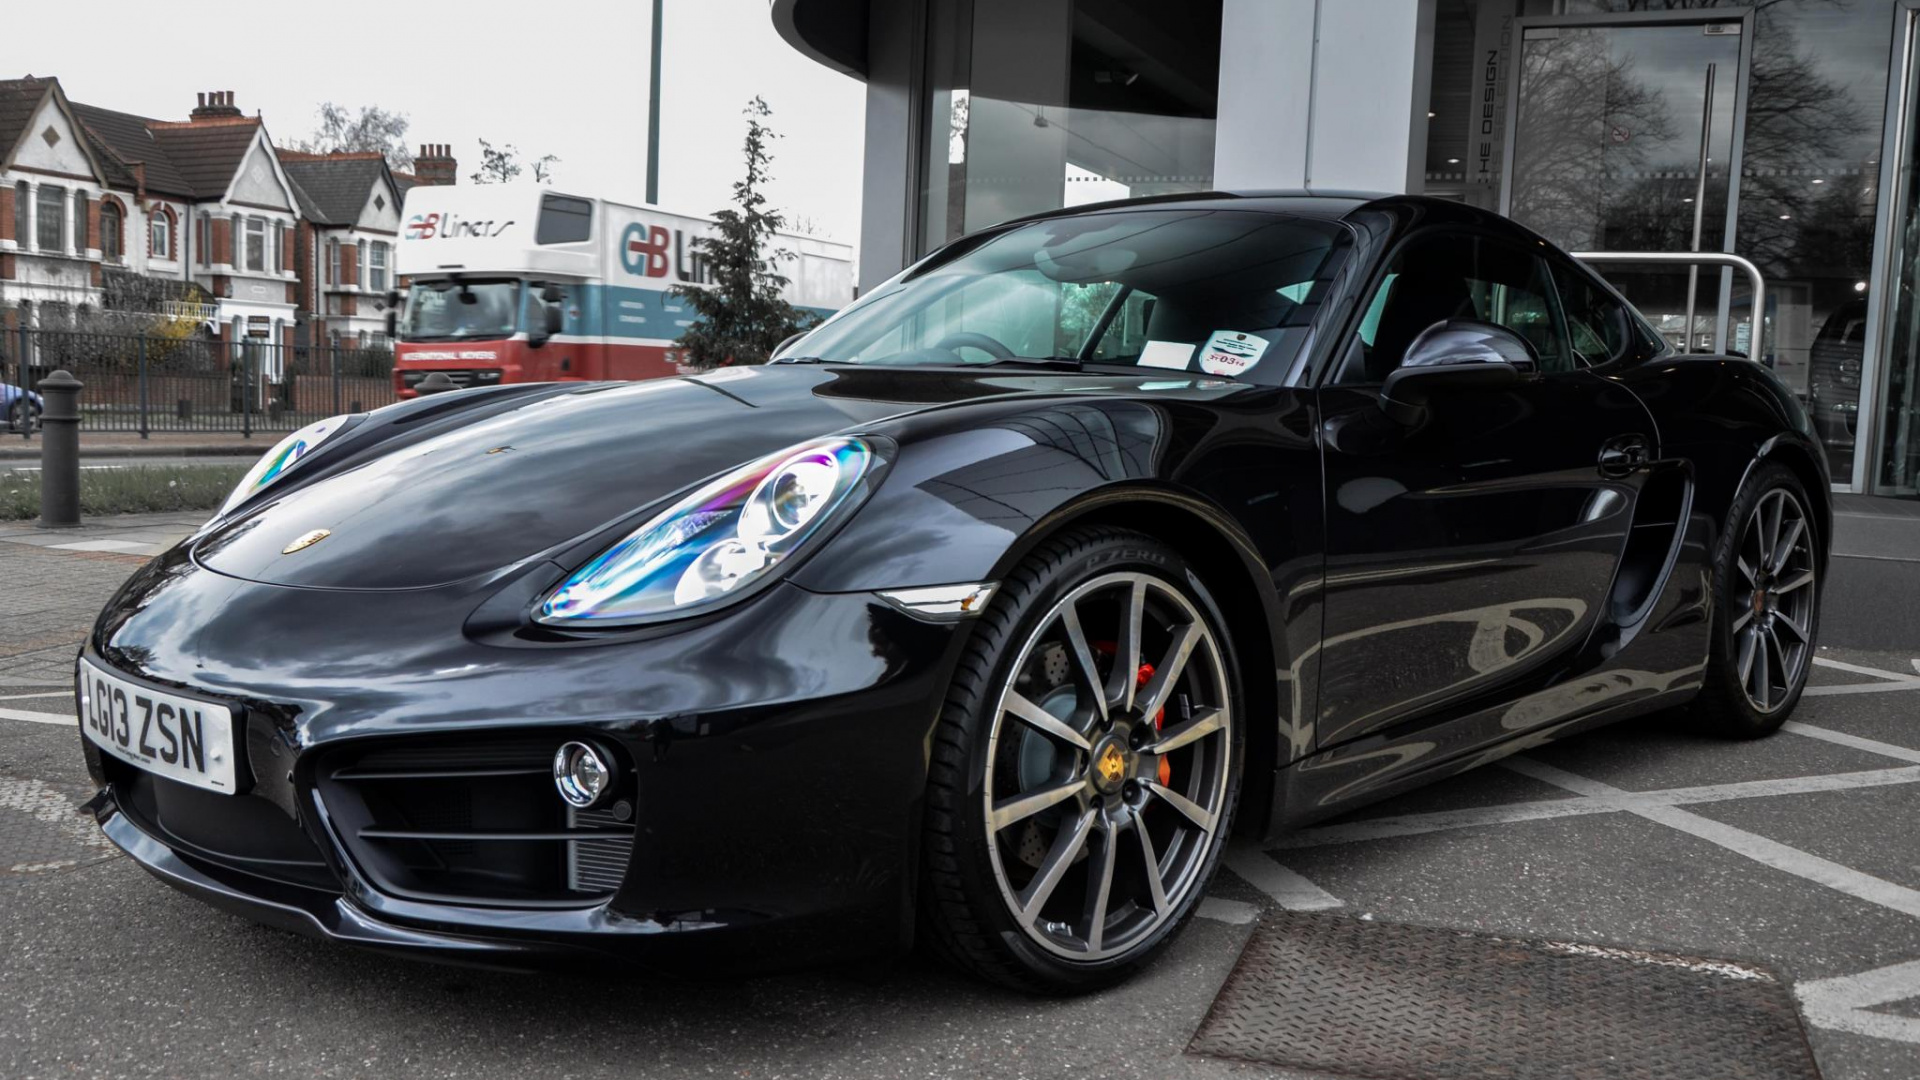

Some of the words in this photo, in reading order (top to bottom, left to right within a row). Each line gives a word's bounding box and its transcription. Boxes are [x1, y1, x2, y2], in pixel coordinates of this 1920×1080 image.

[1482, 50, 1498, 135] DESIGN
[1493, 14, 1512, 142] SELECTION
[620, 222, 670, 278] GB
[674, 229, 714, 285] Lin
[1105, 549, 1166, 565] ZERO
[86, 669, 130, 748] LG13
[135, 694, 206, 773] ZSN
